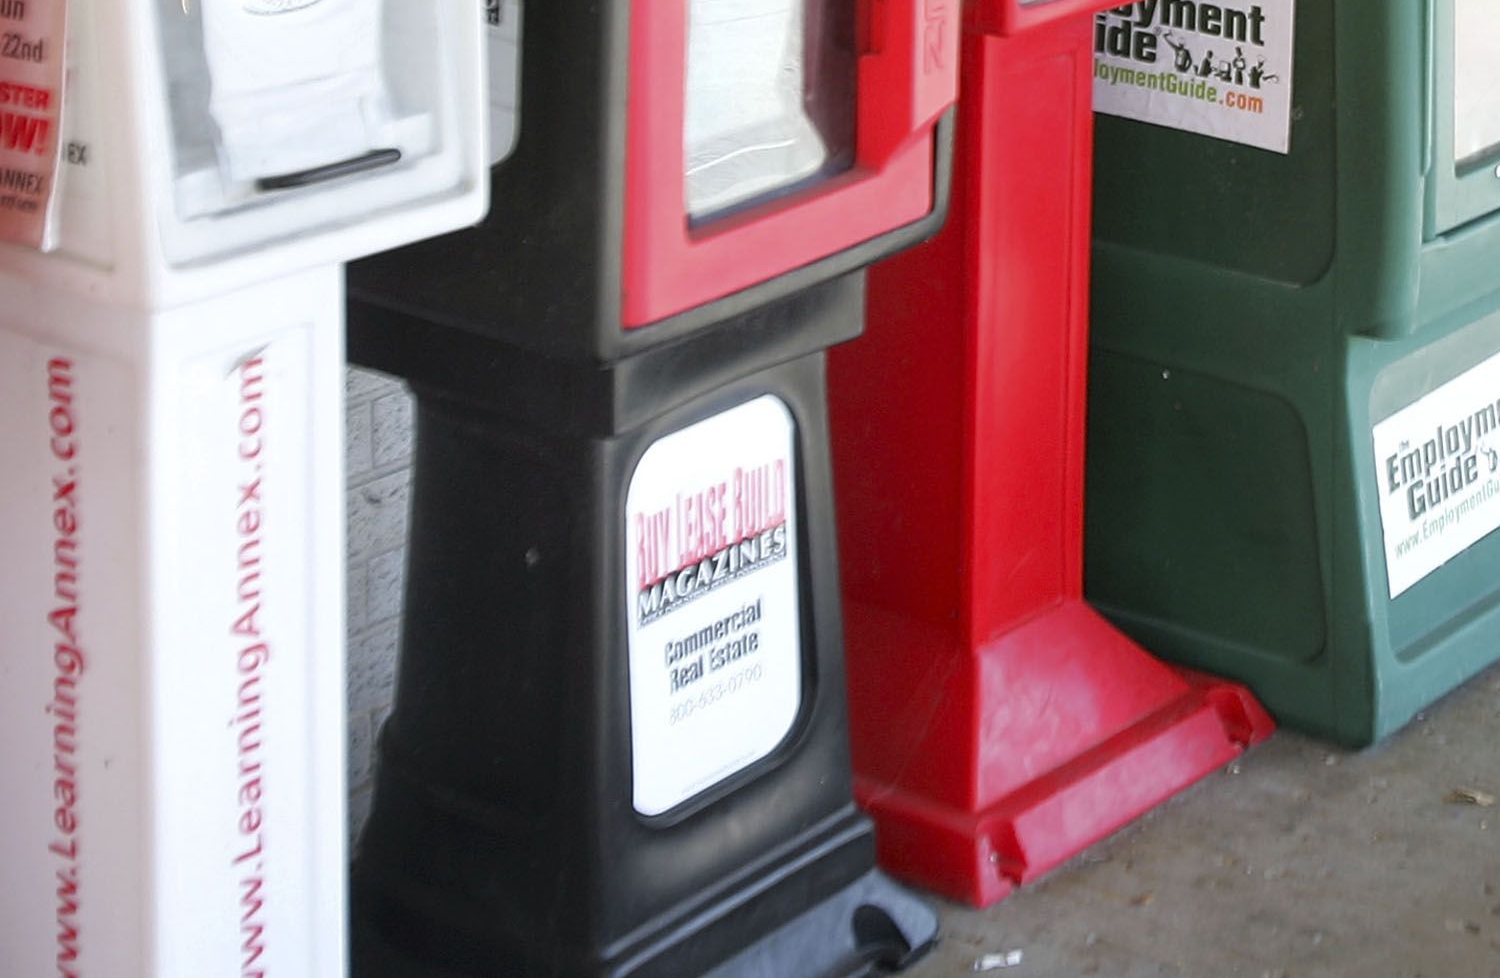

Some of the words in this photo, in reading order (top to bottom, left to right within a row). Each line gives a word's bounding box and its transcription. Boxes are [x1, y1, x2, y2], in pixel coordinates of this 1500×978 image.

[1407, 451, 1478, 521] Guide
[637, 522, 787, 620] MAGAZINES
[46, 357, 85, 978] ww.LearningAnnex.com
[228, 356, 270, 978] ww.LearningAnnex.com
[664, 595, 762, 667] Commercial
[669, 655, 704, 695] Real
[710, 630, 759, 671] Estate
